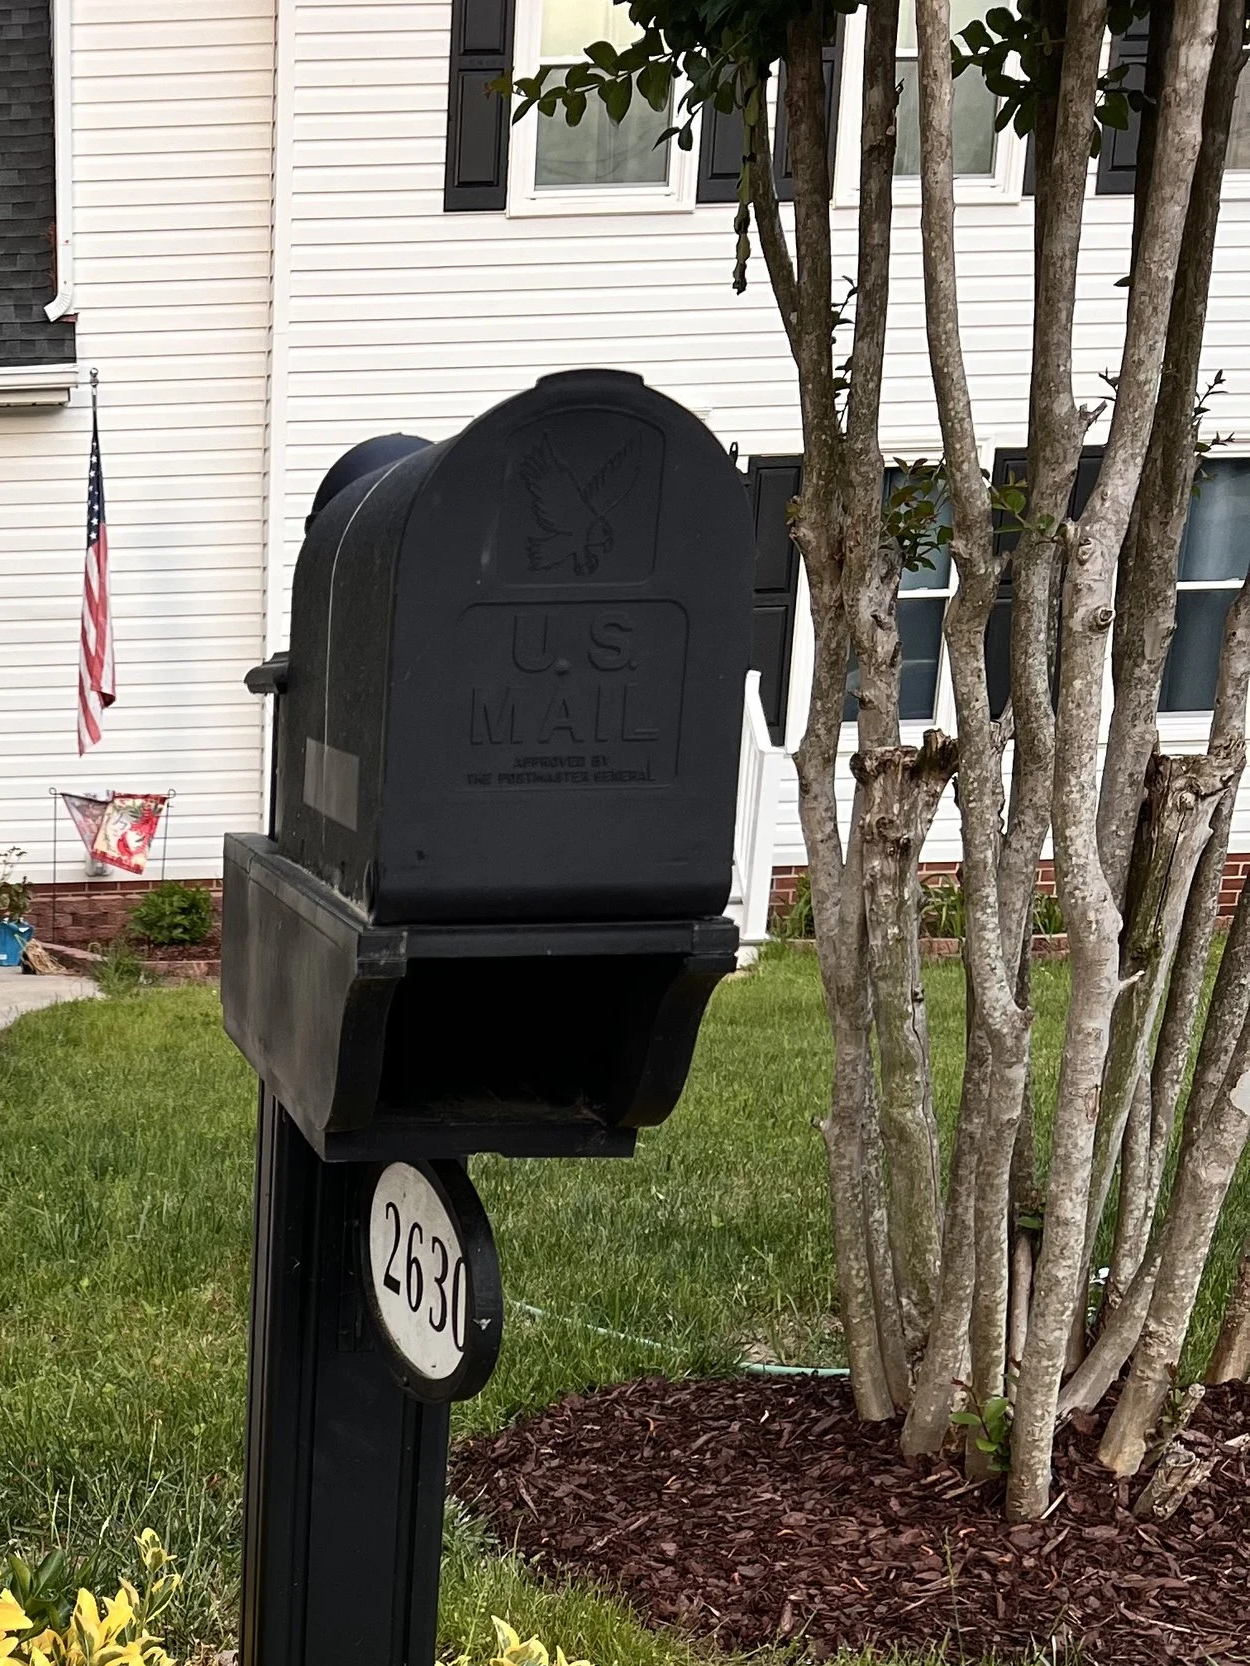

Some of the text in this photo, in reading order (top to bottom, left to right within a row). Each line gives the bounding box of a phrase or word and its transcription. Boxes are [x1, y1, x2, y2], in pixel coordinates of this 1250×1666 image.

[469, 682, 661, 746] MAIL
[466, 773, 493, 785] THE
[513, 755, 609, 768] APPROVED BY
[383, 1201, 468, 1353] 2630
